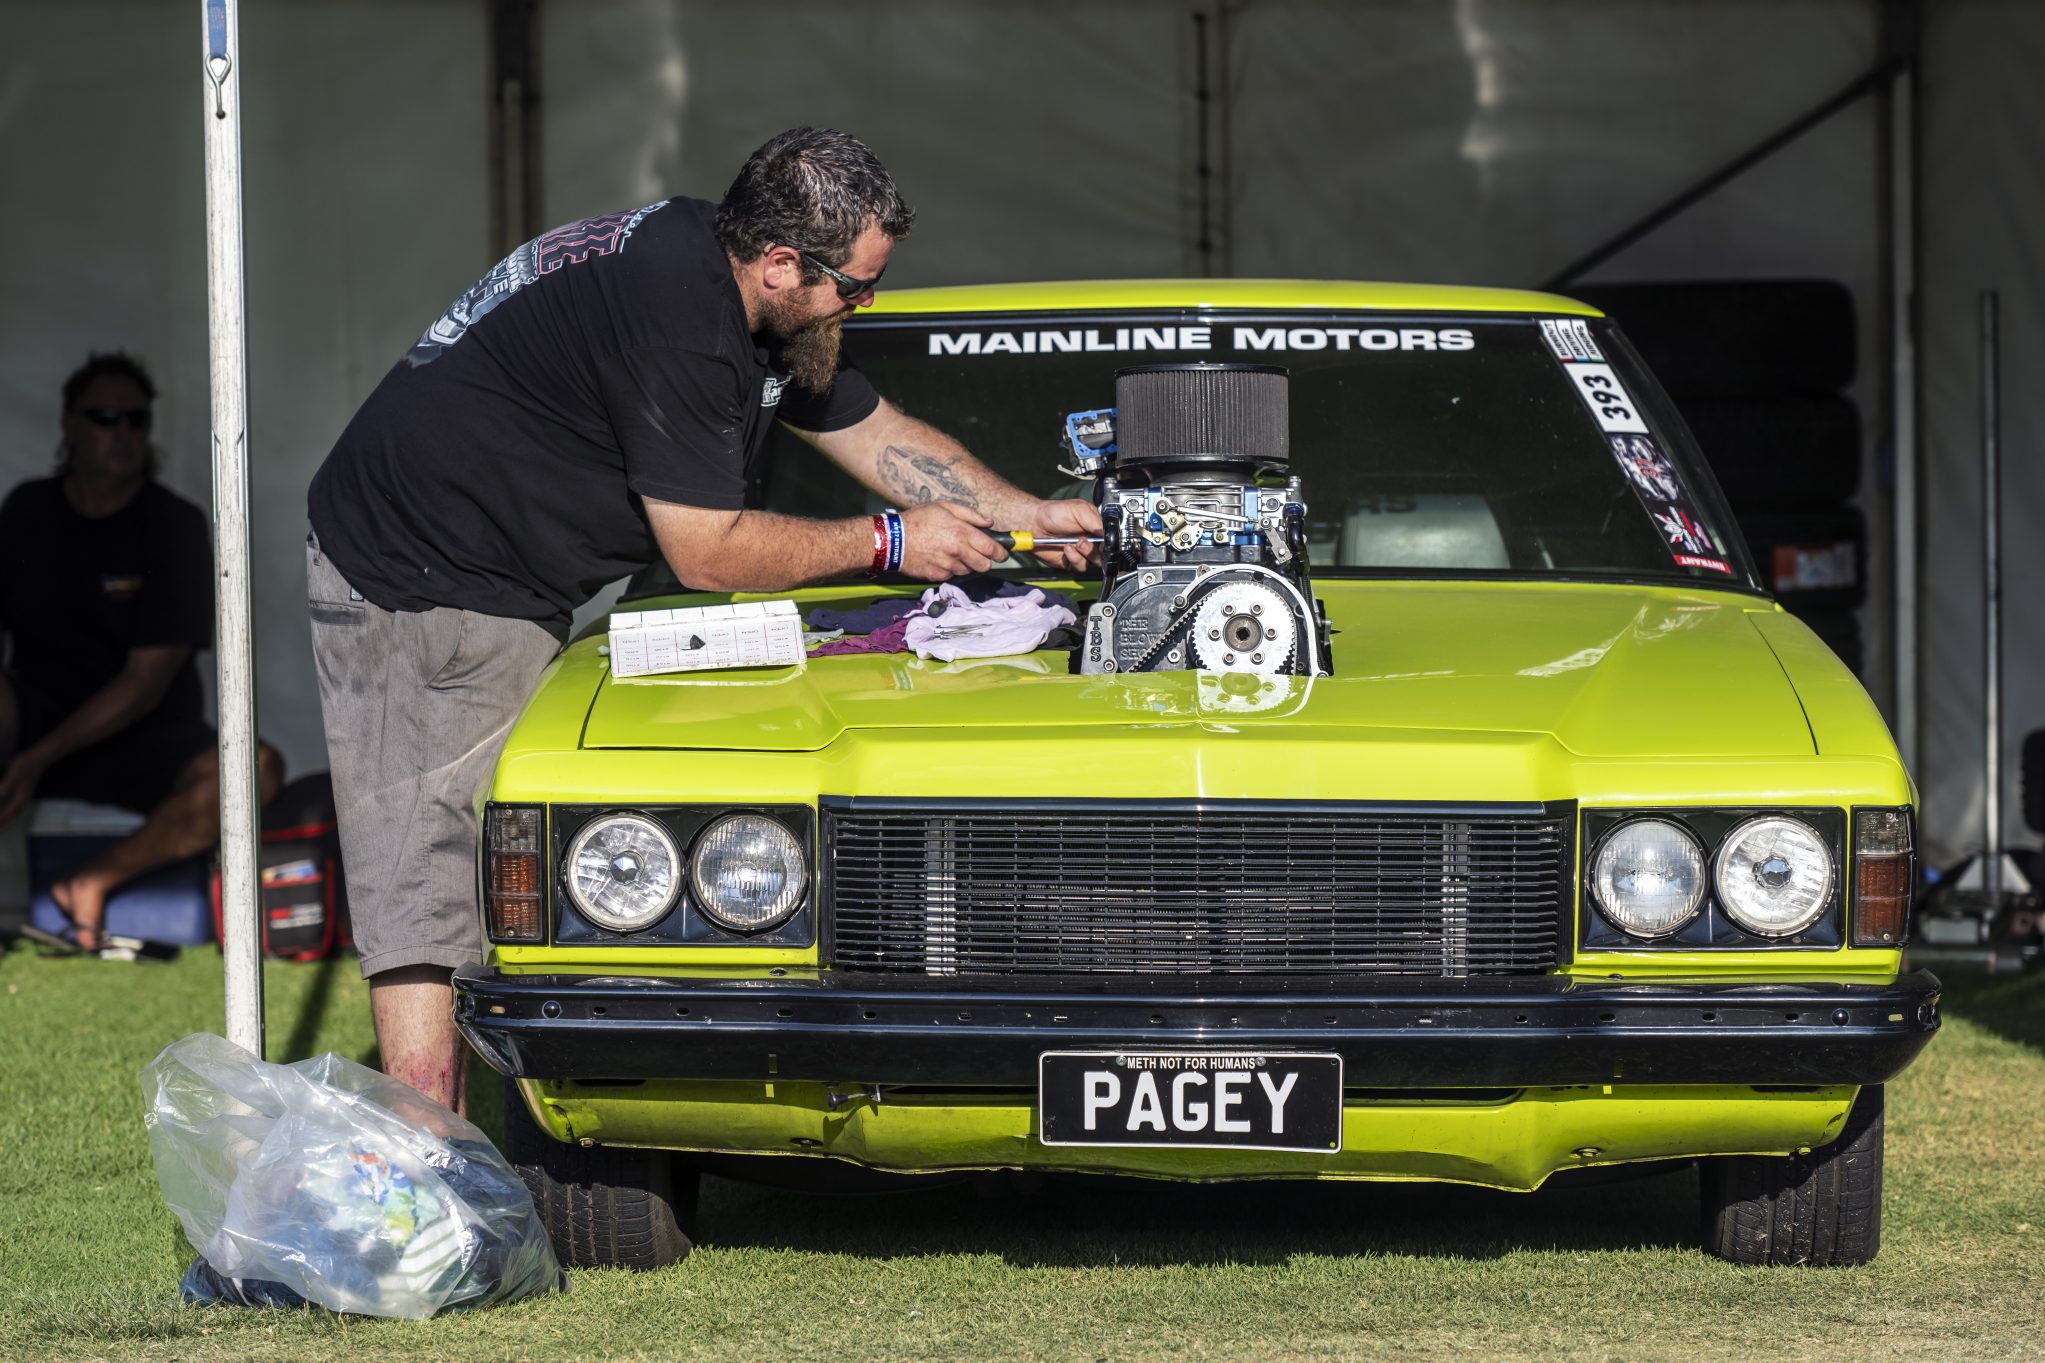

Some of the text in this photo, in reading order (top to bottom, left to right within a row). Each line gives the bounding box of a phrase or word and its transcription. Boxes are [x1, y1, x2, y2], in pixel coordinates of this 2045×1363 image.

[928, 326, 1475, 354] MAINLINE MOTORS
[1582, 374, 1632, 421] 393
[1680, 556, 1726, 571] ENTRANT
[1120, 632, 1163, 645] BLOW
[1127, 1057, 1256, 1070] METH NOT FOR HUMANS
[1083, 1071, 1299, 1134] PAGEY
